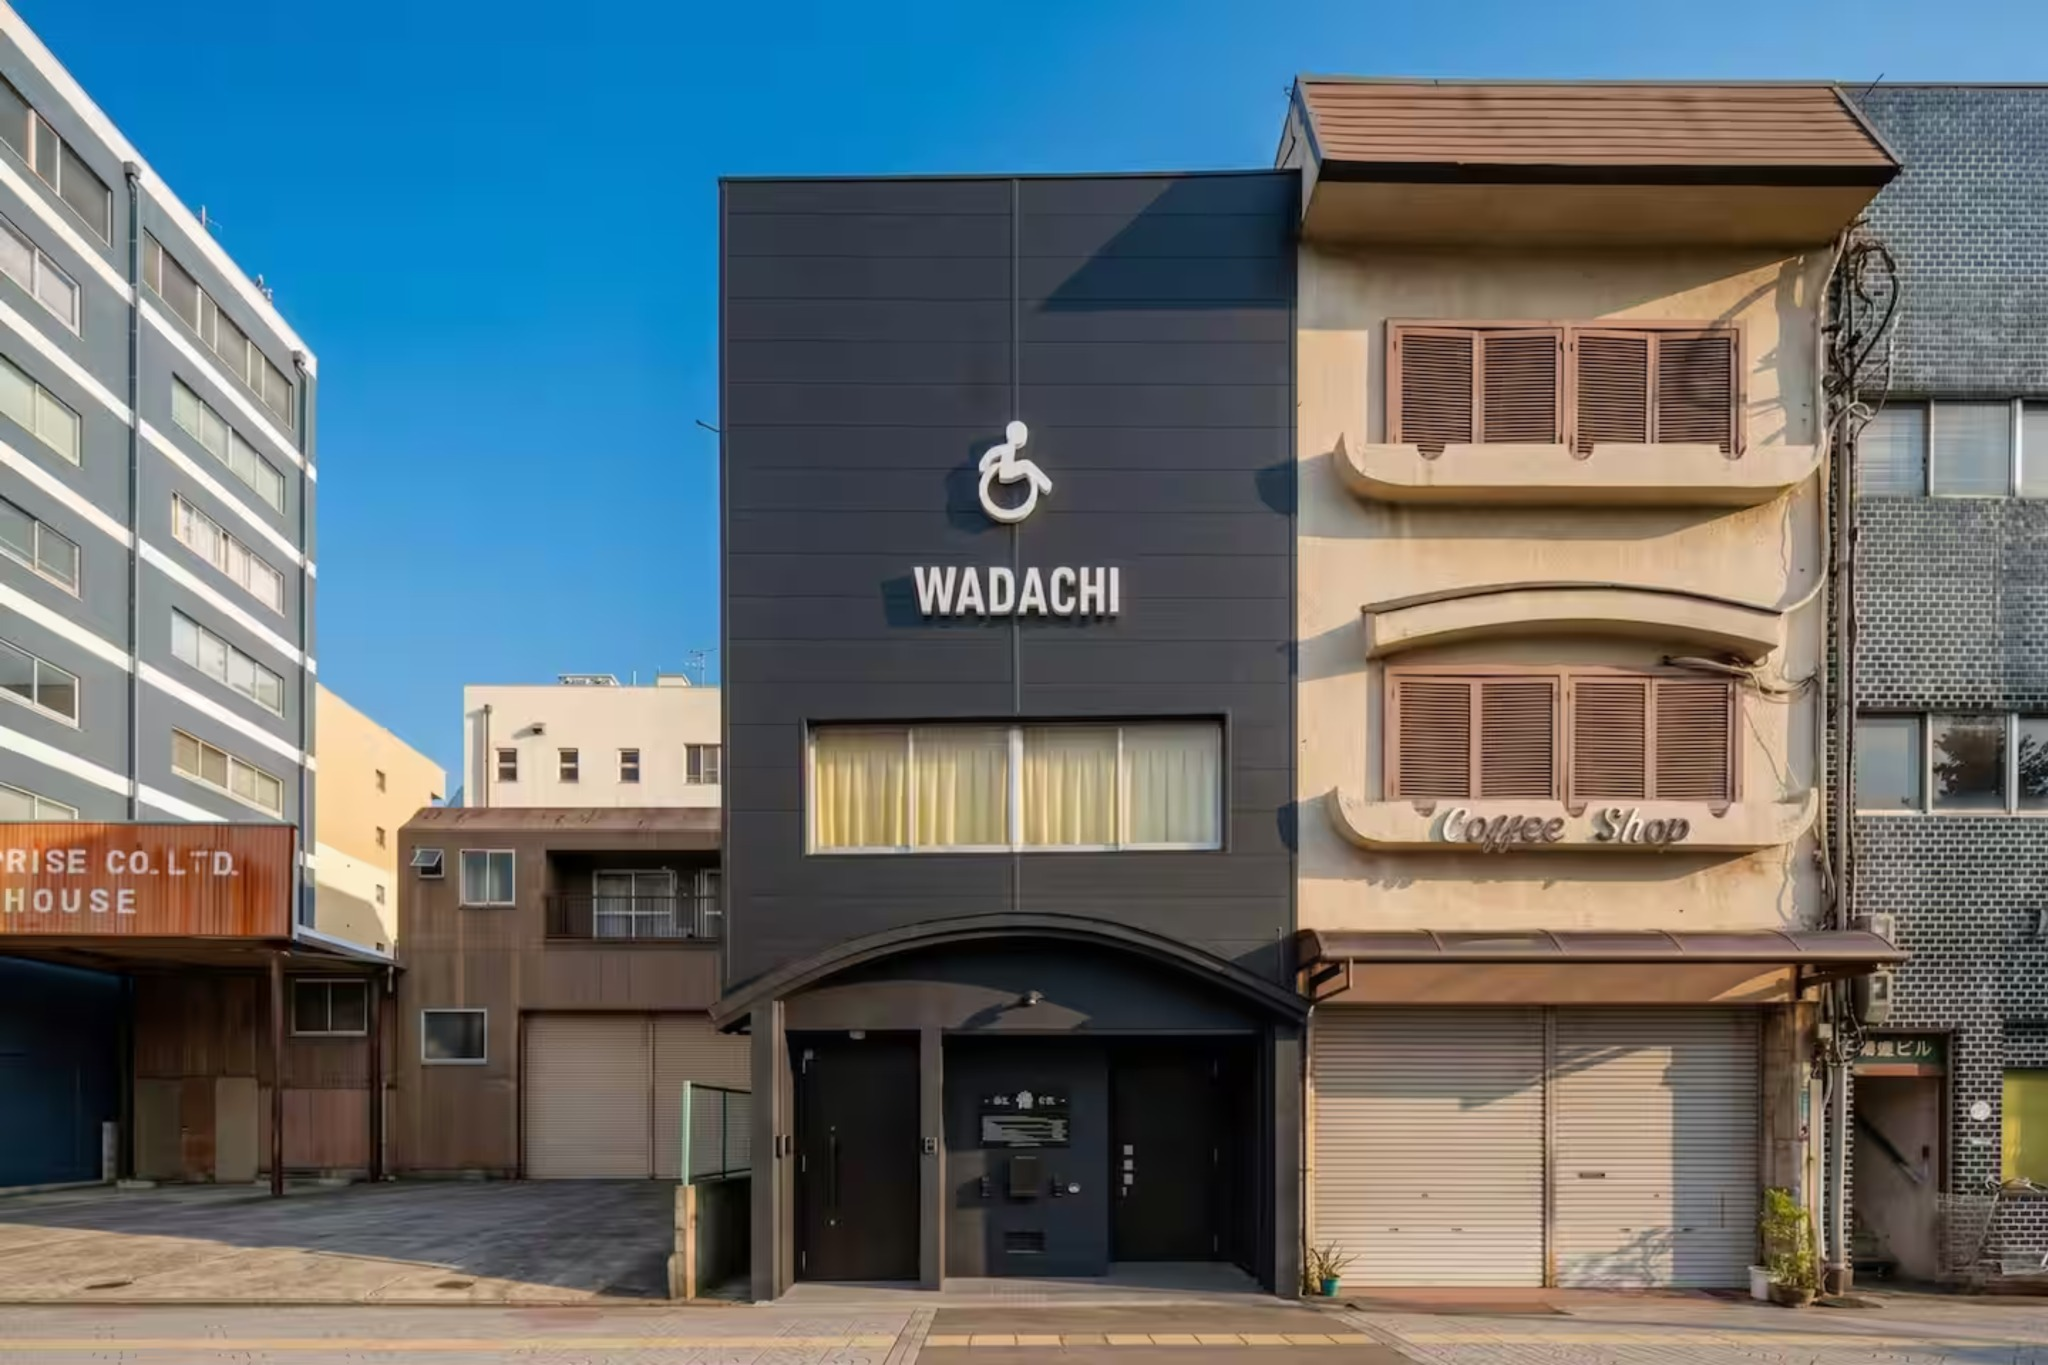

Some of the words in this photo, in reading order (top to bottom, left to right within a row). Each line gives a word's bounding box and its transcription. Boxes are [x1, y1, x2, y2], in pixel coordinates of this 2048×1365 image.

[913, 566, 1119, 616] WADACHI
[1442, 807, 1565, 852] Coffee
[1594, 807, 1690, 852] Shop
[0, 849, 86, 874] RISE
[4, 888, 136, 913] HOUSE
